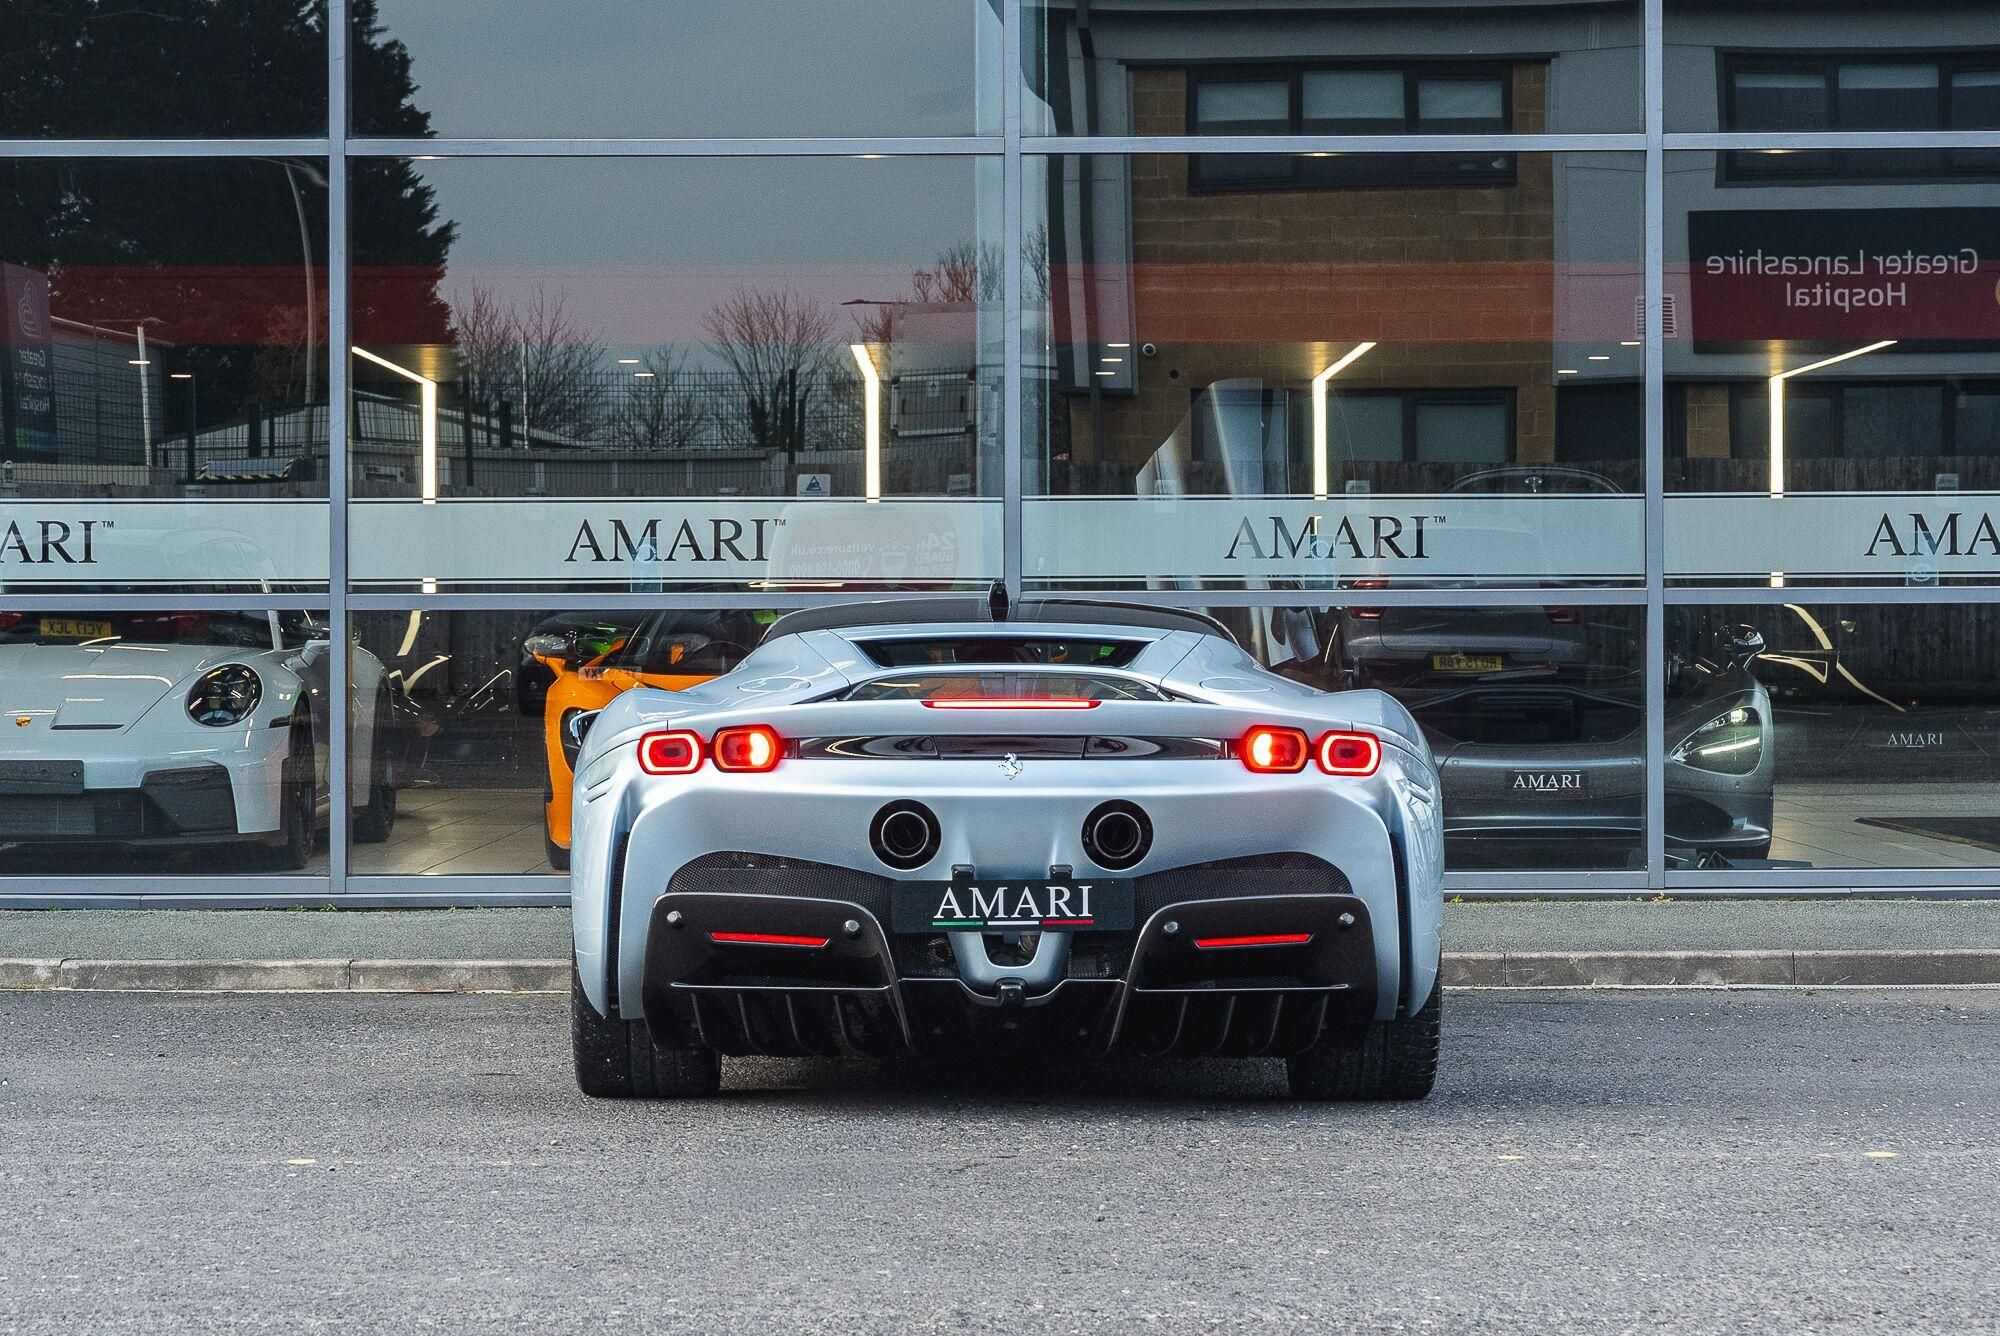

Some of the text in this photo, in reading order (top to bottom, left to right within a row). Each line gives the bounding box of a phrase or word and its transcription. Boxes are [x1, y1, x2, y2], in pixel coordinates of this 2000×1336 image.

[564, 518, 770, 562] AMARI
[1224, 515, 1430, 559] AMARI
[1887, 732, 1943, 746] AMARI
[1512, 773, 1582, 789] AMARI
[933, 885, 1094, 920] AMARI
